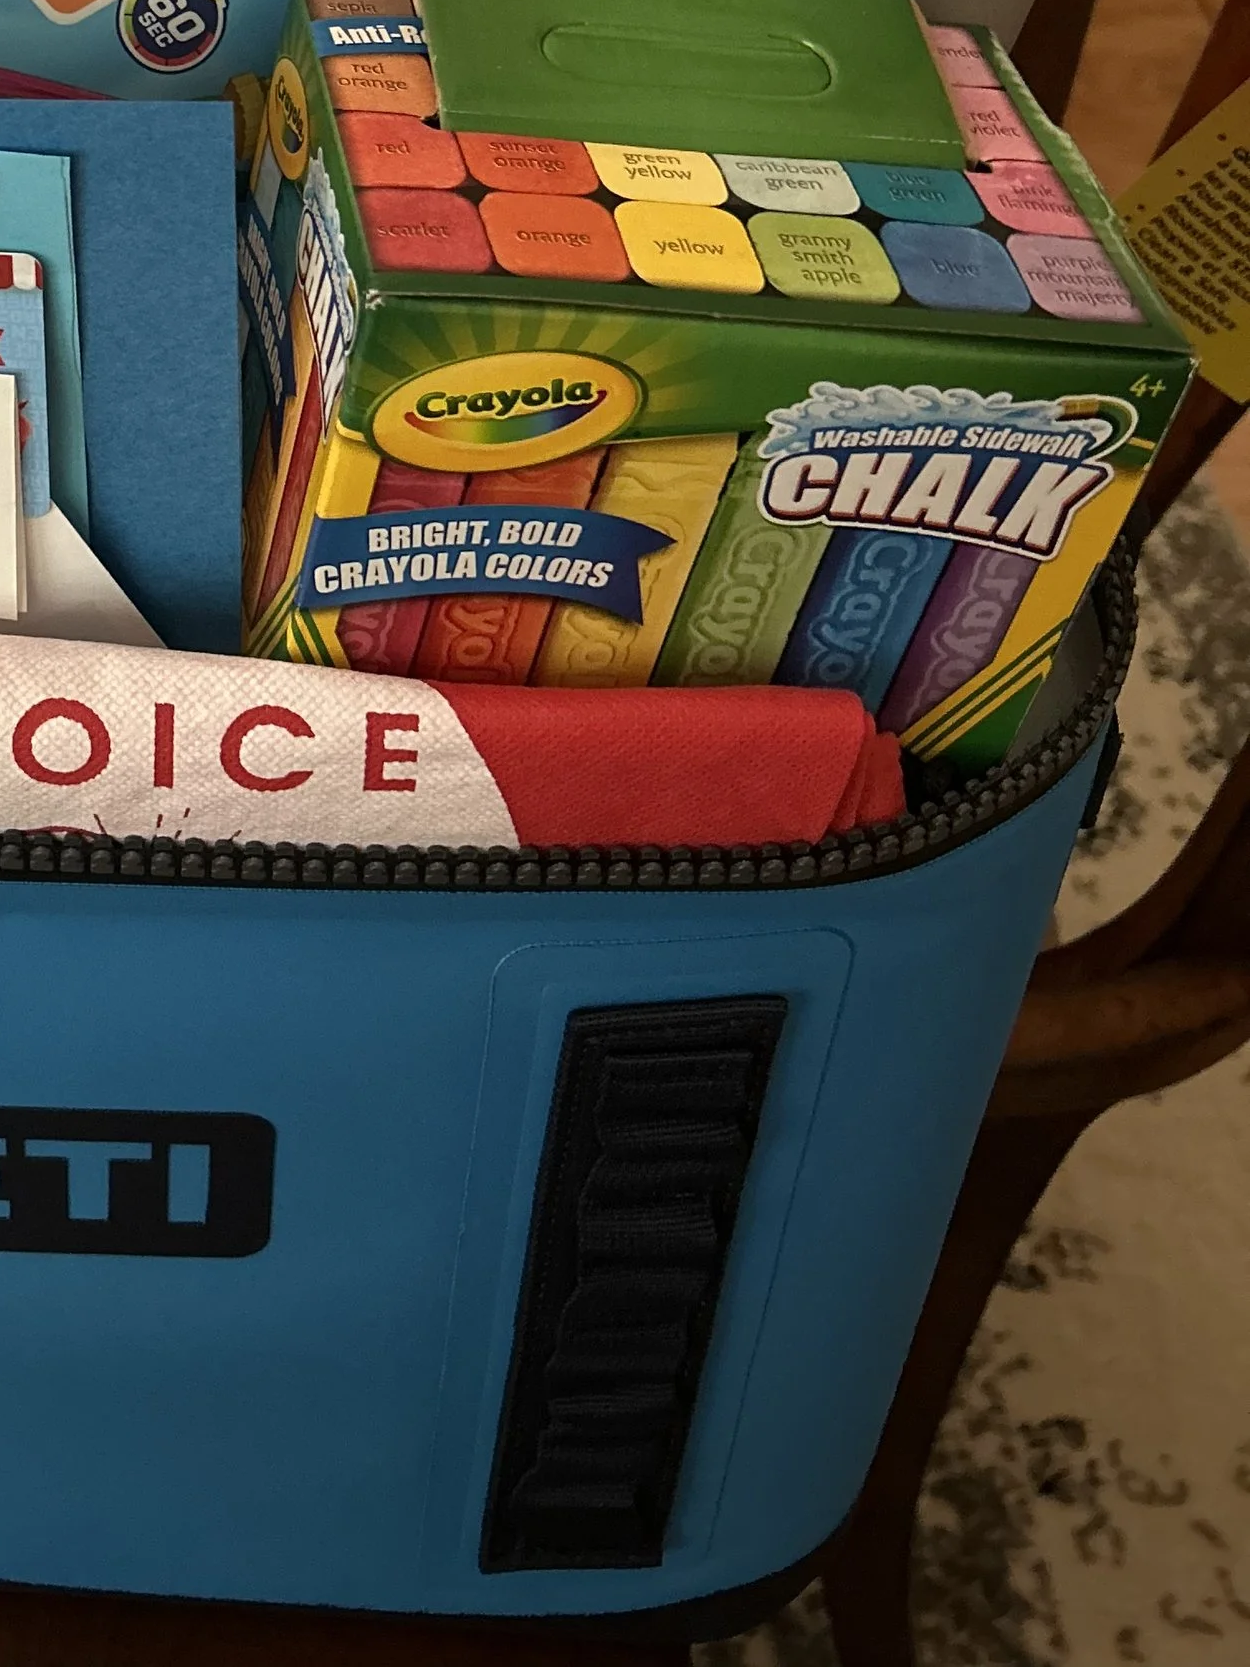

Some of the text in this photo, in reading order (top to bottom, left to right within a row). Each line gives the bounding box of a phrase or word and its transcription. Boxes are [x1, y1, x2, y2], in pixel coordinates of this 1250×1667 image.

[136, 12, 174, 49] SEC
[351, 61, 385, 74] red
[338, 76, 407, 91] orange
[968, 110, 1001, 122] red
[969, 122, 1021, 138] violet
[376, 141, 411, 154] red
[494, 156, 566, 172] orange
[623, 153, 681, 166] green
[735, 160, 837, 177] caribbean
[624, 164, 692, 182] yellow
[765, 176, 823, 192] green
[1000, 195, 1078, 217] flaming
[377, 222, 450, 238] scarlet
[516, 228, 591, 248] orange
[654, 237, 725, 256] yellow
[778, 232, 851, 251] granny
[793, 248, 854, 266] smith
[802, 266, 862, 285] apple
[931, 258, 982, 278] blue
[1129, 374, 1167, 398] 4+
[416, 378, 594, 420] Crayola
[813, 425, 1090, 460] Washable Sidewalk
[765, 451, 1104, 554] CHALK
[368, 520, 584, 554] BRIGHT, BOLD
[314, 551, 615, 594] CRAYOLA COLORS
